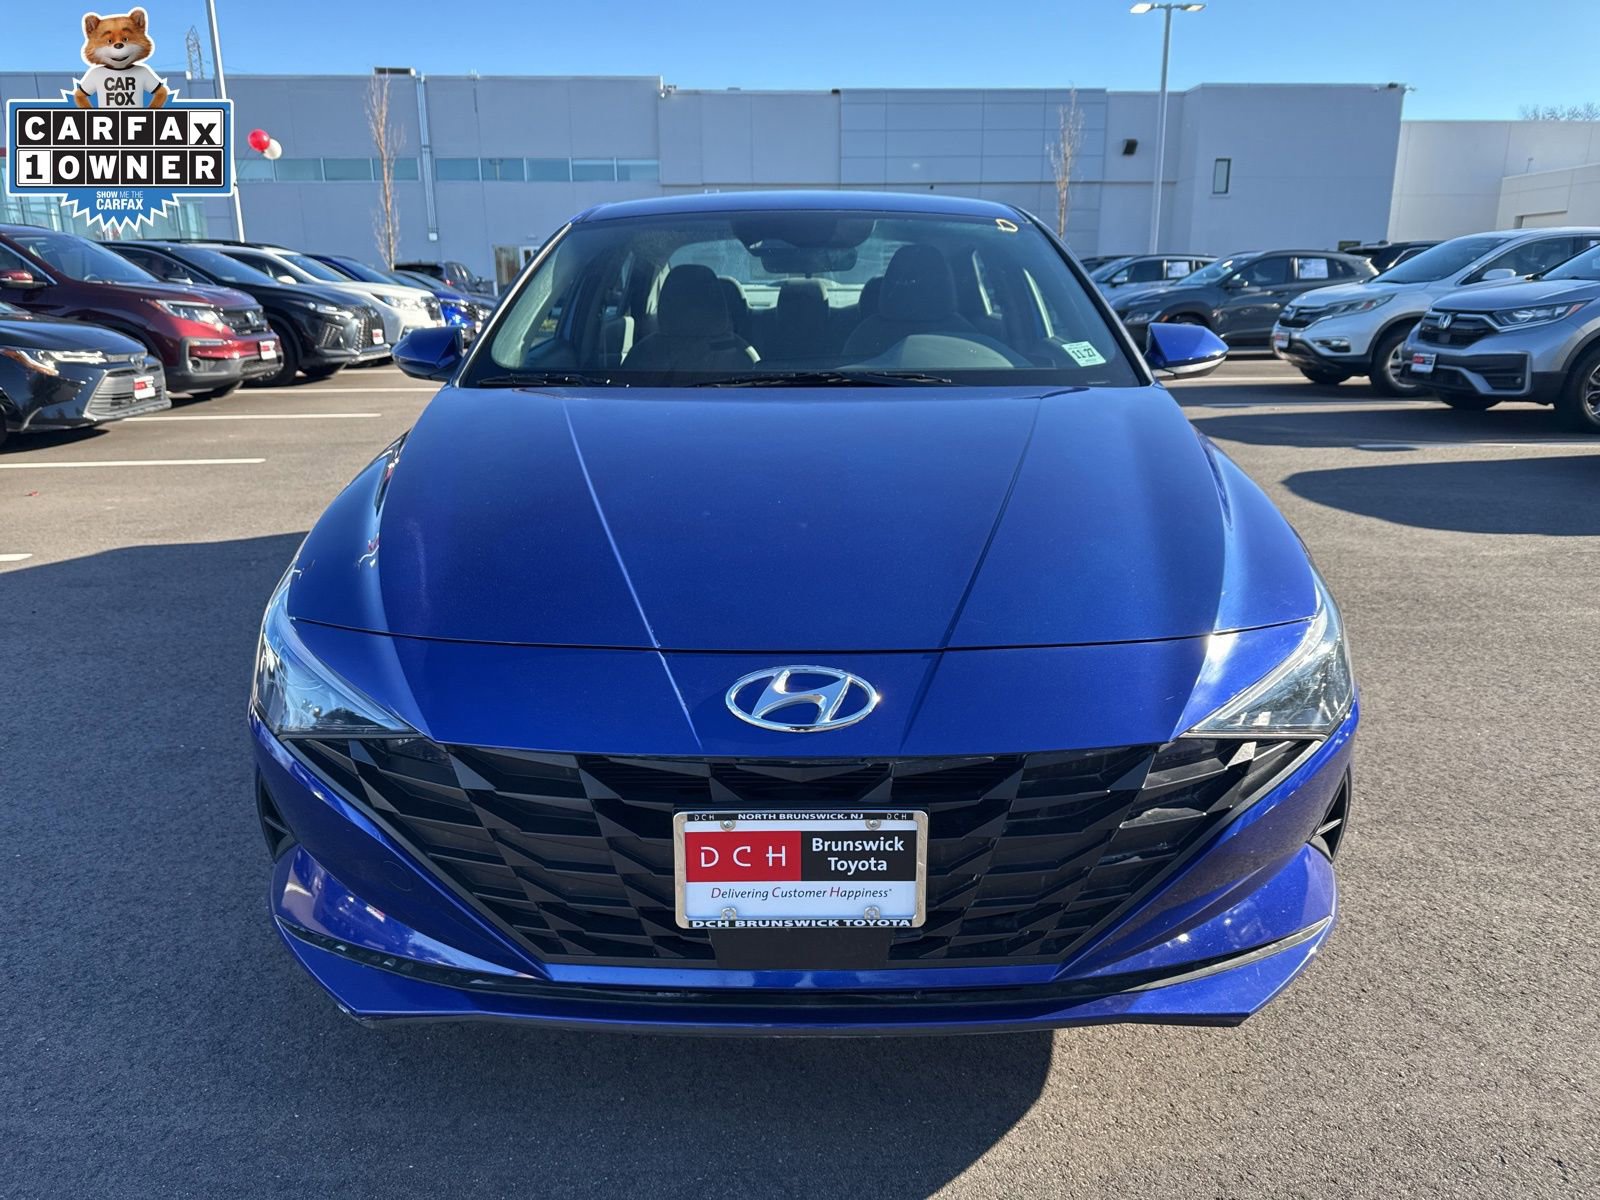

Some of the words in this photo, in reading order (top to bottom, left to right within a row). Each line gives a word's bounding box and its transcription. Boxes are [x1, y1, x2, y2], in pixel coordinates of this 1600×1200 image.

[812, 836, 904, 852] Brunswick
[700, 845, 786, 868] DCH
[827, 857, 887, 876] Toyota
[711, 887, 769, 901] Delivering
[771, 887, 827, 898] Customer
[692, 920, 730, 928] DCH
[735, 919, 841, 928] BRUNSWICK
[843, 919, 910, 927] TOYOTA
